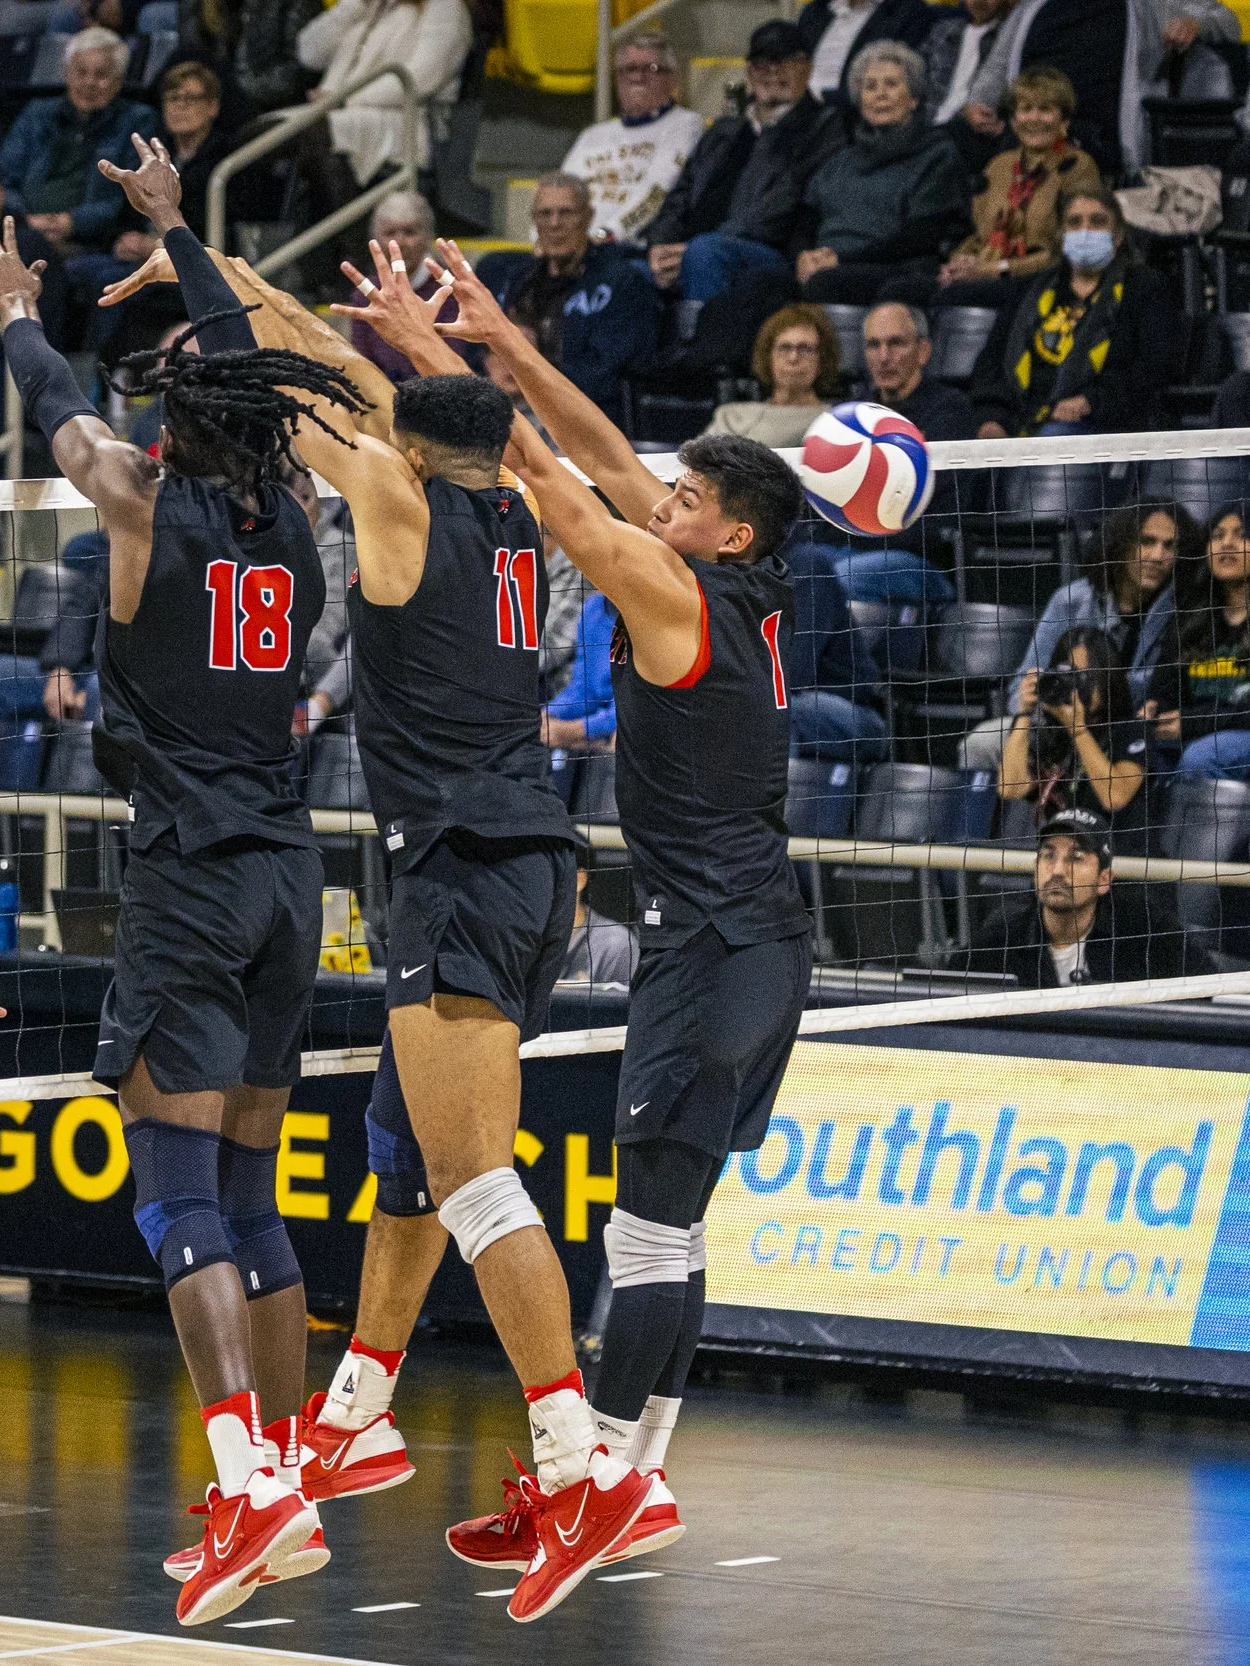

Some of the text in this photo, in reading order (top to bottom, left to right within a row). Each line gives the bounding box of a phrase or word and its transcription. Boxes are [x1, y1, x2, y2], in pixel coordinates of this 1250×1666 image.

[205, 559, 294, 672] 18
[493, 548, 539, 650] 11
[760, 610, 788, 710] 1
[719, 1100, 1215, 1232] outhland
[749, 1219, 1185, 1298] CREDIT UNION
